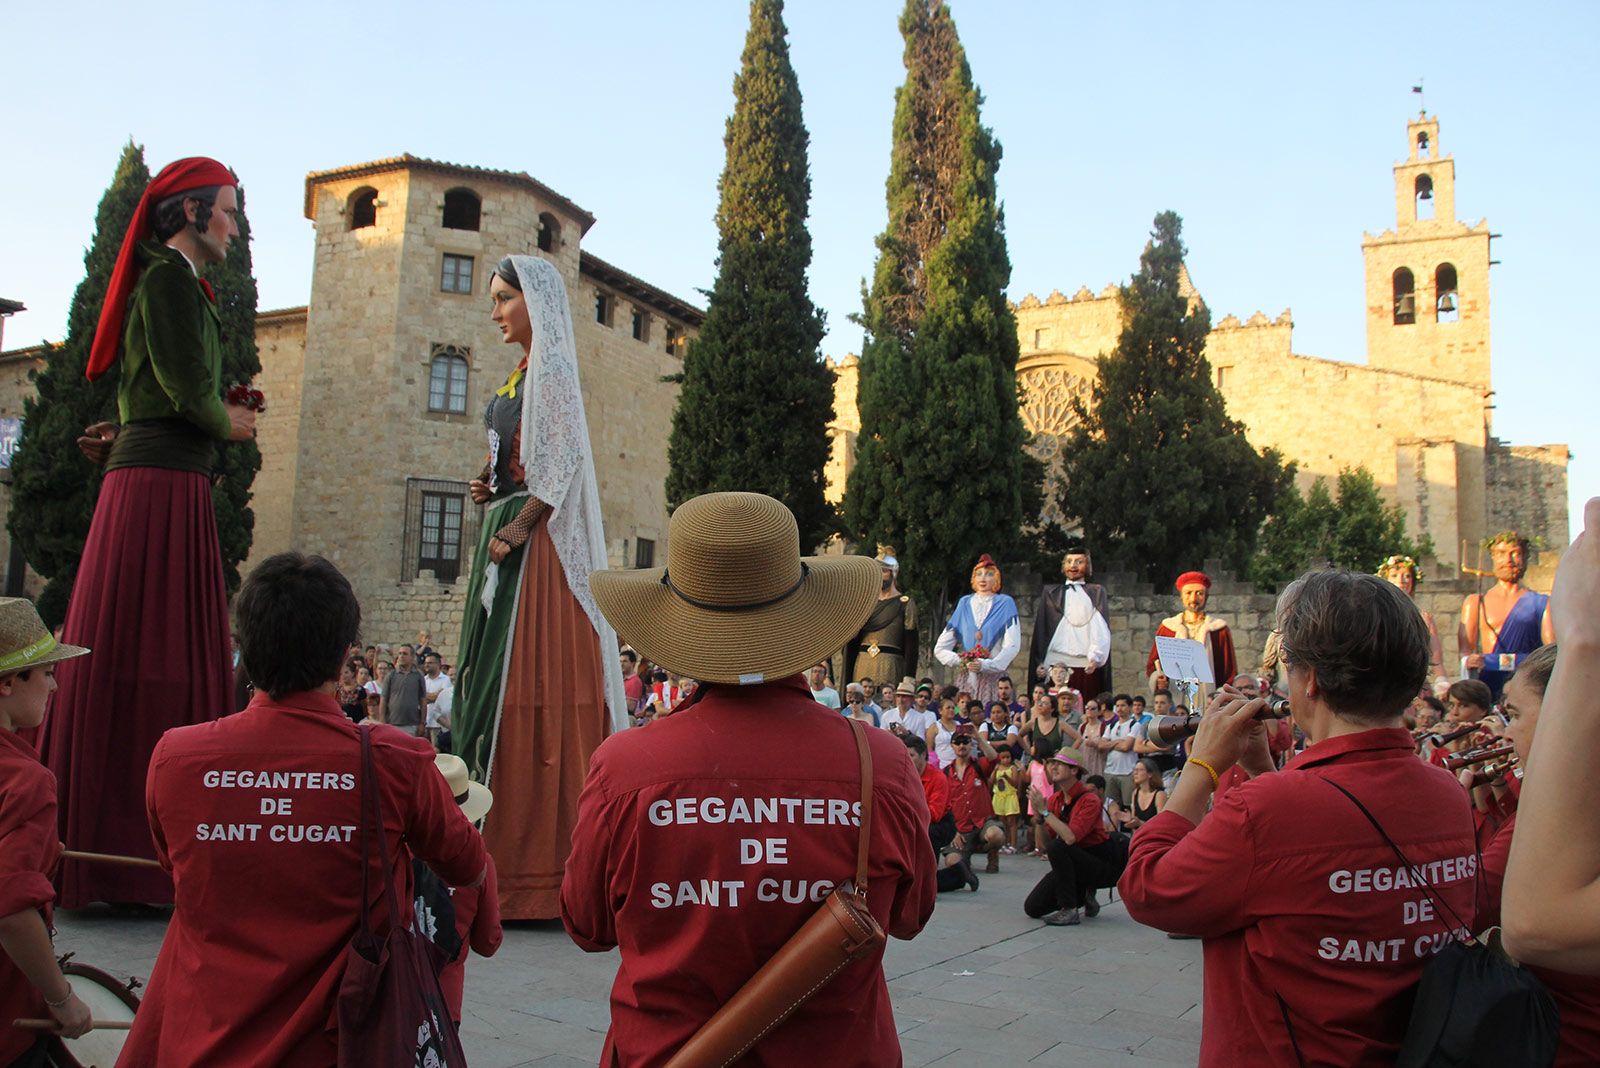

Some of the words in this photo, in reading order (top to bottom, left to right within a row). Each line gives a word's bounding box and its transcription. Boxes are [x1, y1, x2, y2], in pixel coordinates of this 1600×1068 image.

[203, 770, 355, 791] GEGANTERS
[260, 797, 293, 816] DE
[195, 823, 262, 842] SANT
[269, 824, 357, 843] CUGAT
[740, 838, 789, 865] DE
[1328, 854, 1478, 894] GEGANTERS
[650, 879, 745, 909] SANT
[757, 878, 855, 904] CUG
[1403, 898, 1434, 925] DE
[1317, 937, 1406, 962] SANT
